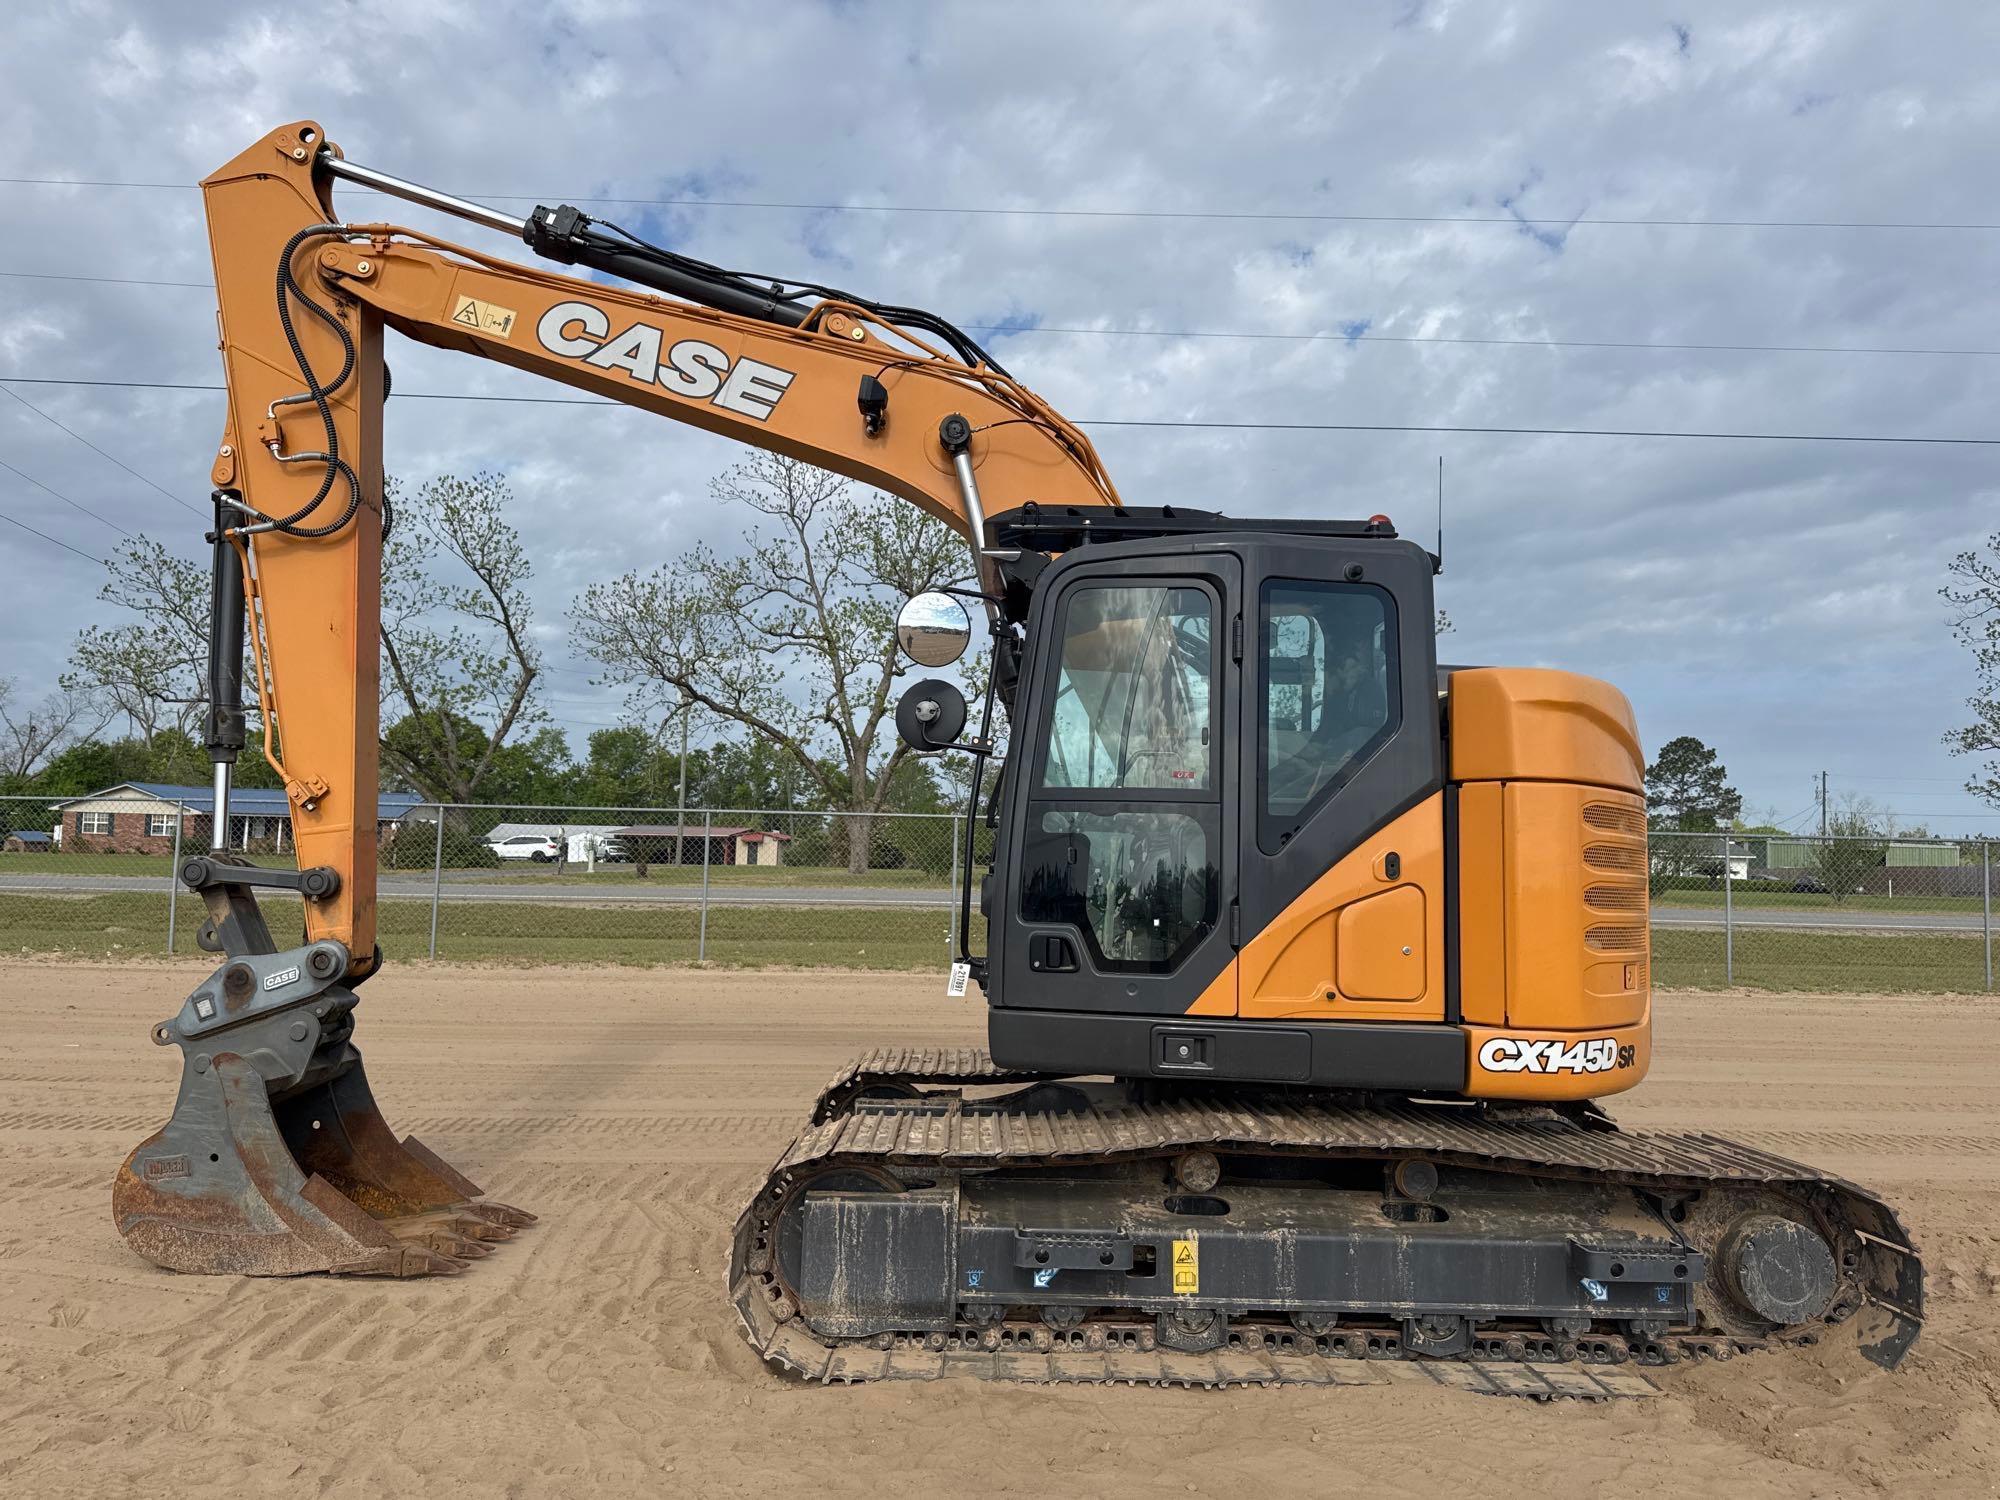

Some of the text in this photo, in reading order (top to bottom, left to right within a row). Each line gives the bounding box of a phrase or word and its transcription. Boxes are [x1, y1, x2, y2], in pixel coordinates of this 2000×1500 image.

[536, 301, 797, 422] CASE
[266, 970, 296, 987] CASE
[1478, 1037, 1636, 1075] CX145D SR
